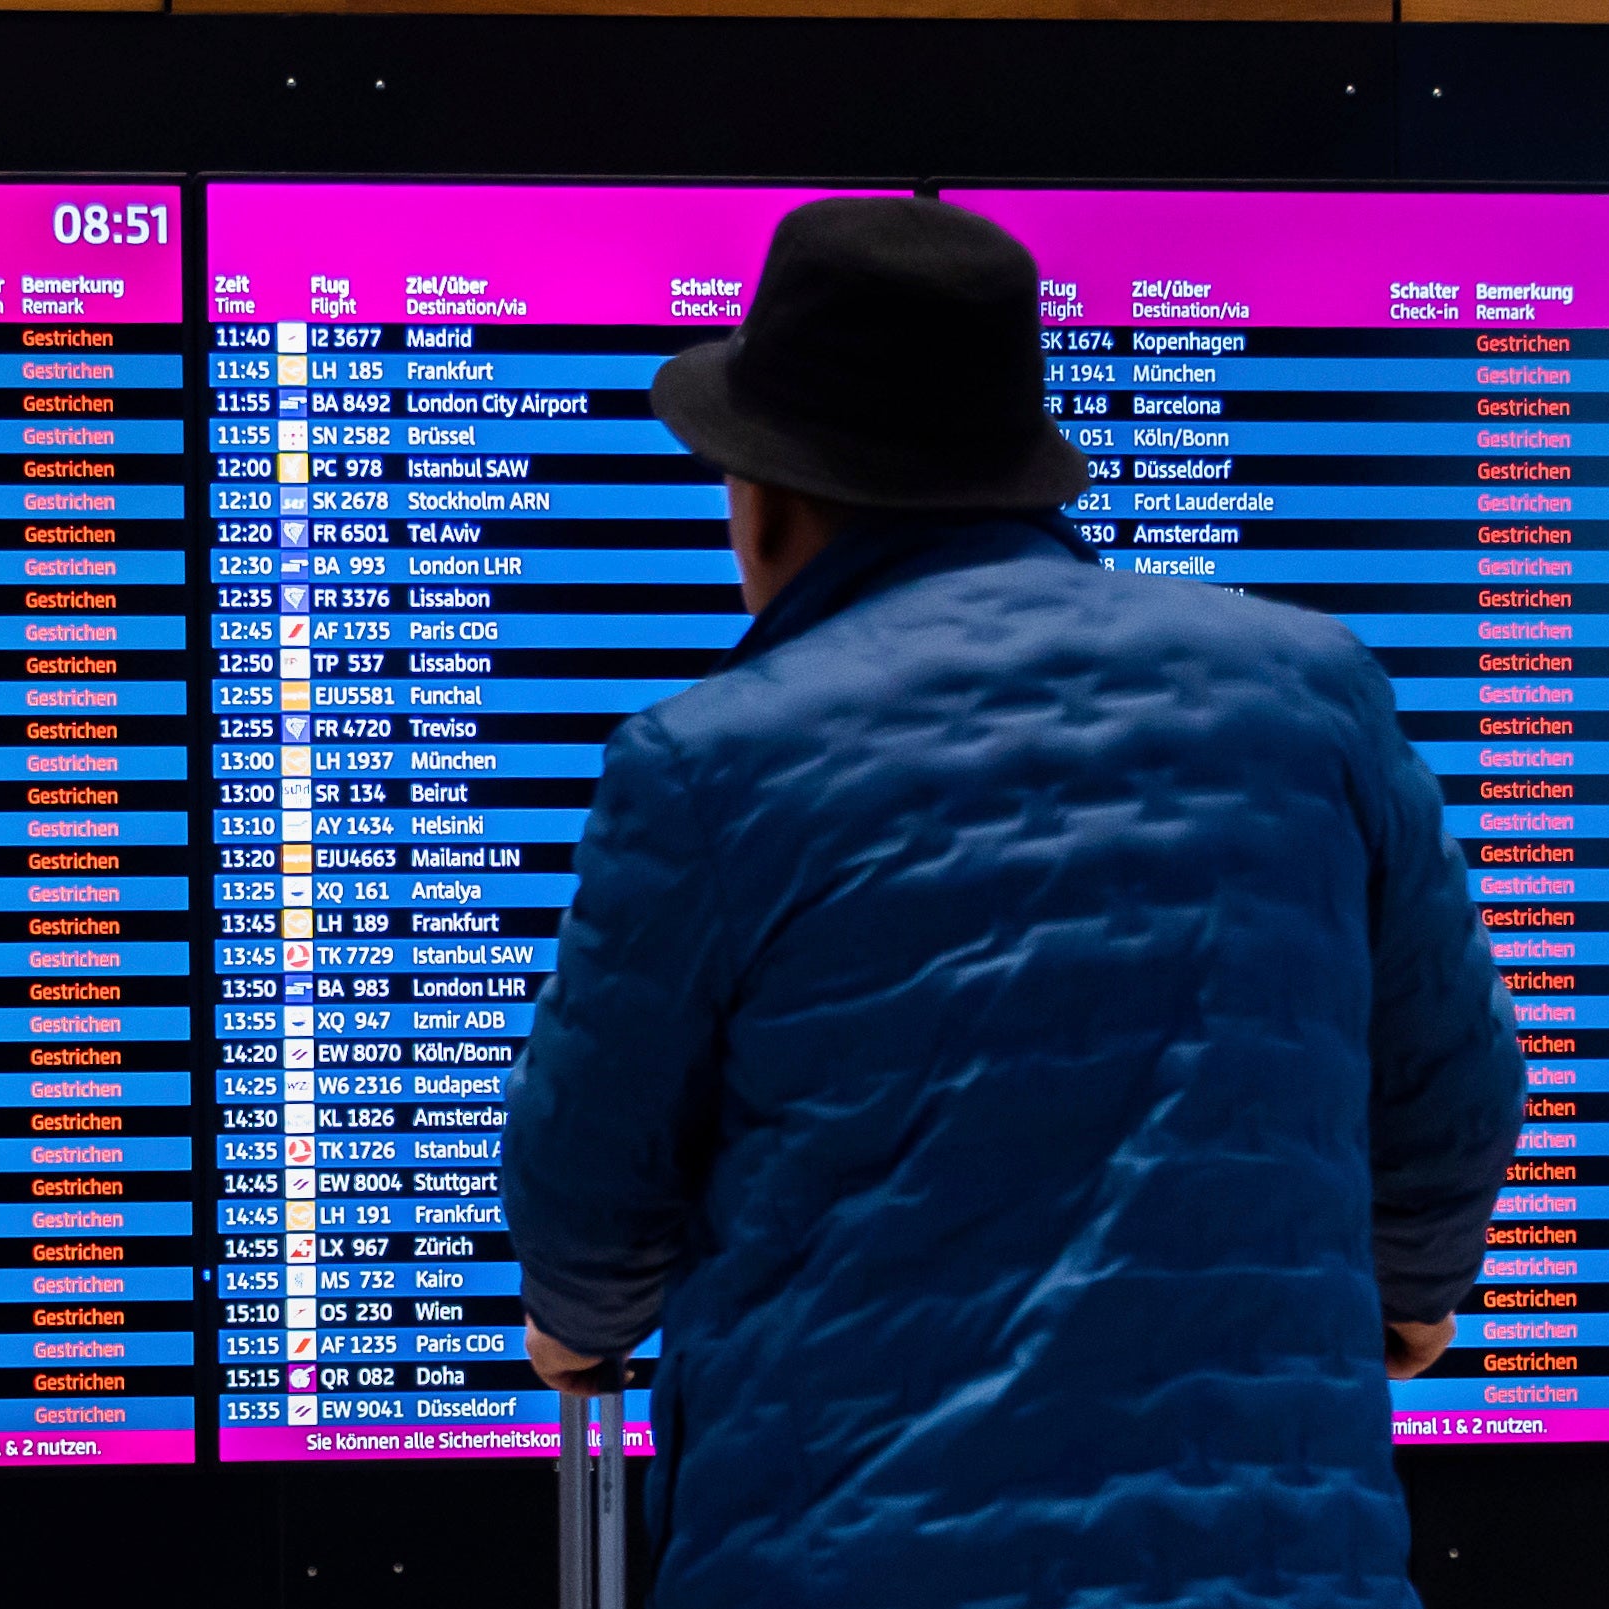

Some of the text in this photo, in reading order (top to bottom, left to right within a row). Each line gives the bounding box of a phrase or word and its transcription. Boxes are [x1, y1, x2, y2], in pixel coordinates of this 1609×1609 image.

[53, 204, 168, 245] 08:51
[21, 275, 125, 301] Bemerkung
[214, 274, 743, 301] Zeit Flug Ziel/über Schalter
[1040, 279, 1574, 307] Flug Ziel/über Schalter Bemerkung
[22, 297, 85, 315] Remark
[214, 296, 742, 319] Time Flight Destination/via Check-in
[1040, 300, 1536, 322] Flight Destination/via Check-in Remark
[22, 329, 114, 347] Gestrichen
[216, 327, 472, 348] 11:40 I2 3677 Madrid
[1133, 331, 1570, 356] Kopenhagen Gestrichen
[217, 360, 494, 381] 11:45 LH 185 Frankfurt
[23, 394, 114, 413] Gestrichen
[1133, 395, 1221, 415] Barcelona
[1133, 427, 1229, 449] Köln/Bonn
[1134, 492, 1274, 511] Fort Lauderdale
[24, 525, 115, 543] Gestrichen
[220, 685, 482, 706] 12:55 EJU5581 Funchal
[412, 911, 500, 932] Frankfurt
[32, 1307, 125, 1326] Gestrichen
[227, 1396, 517, 1420] 15:35 EW 9041 Düsseldorf
[5, 1440, 19, 1457] &
[22, 1439, 34, 1456] 2
[36, 1438, 102, 1456] nutzen.
